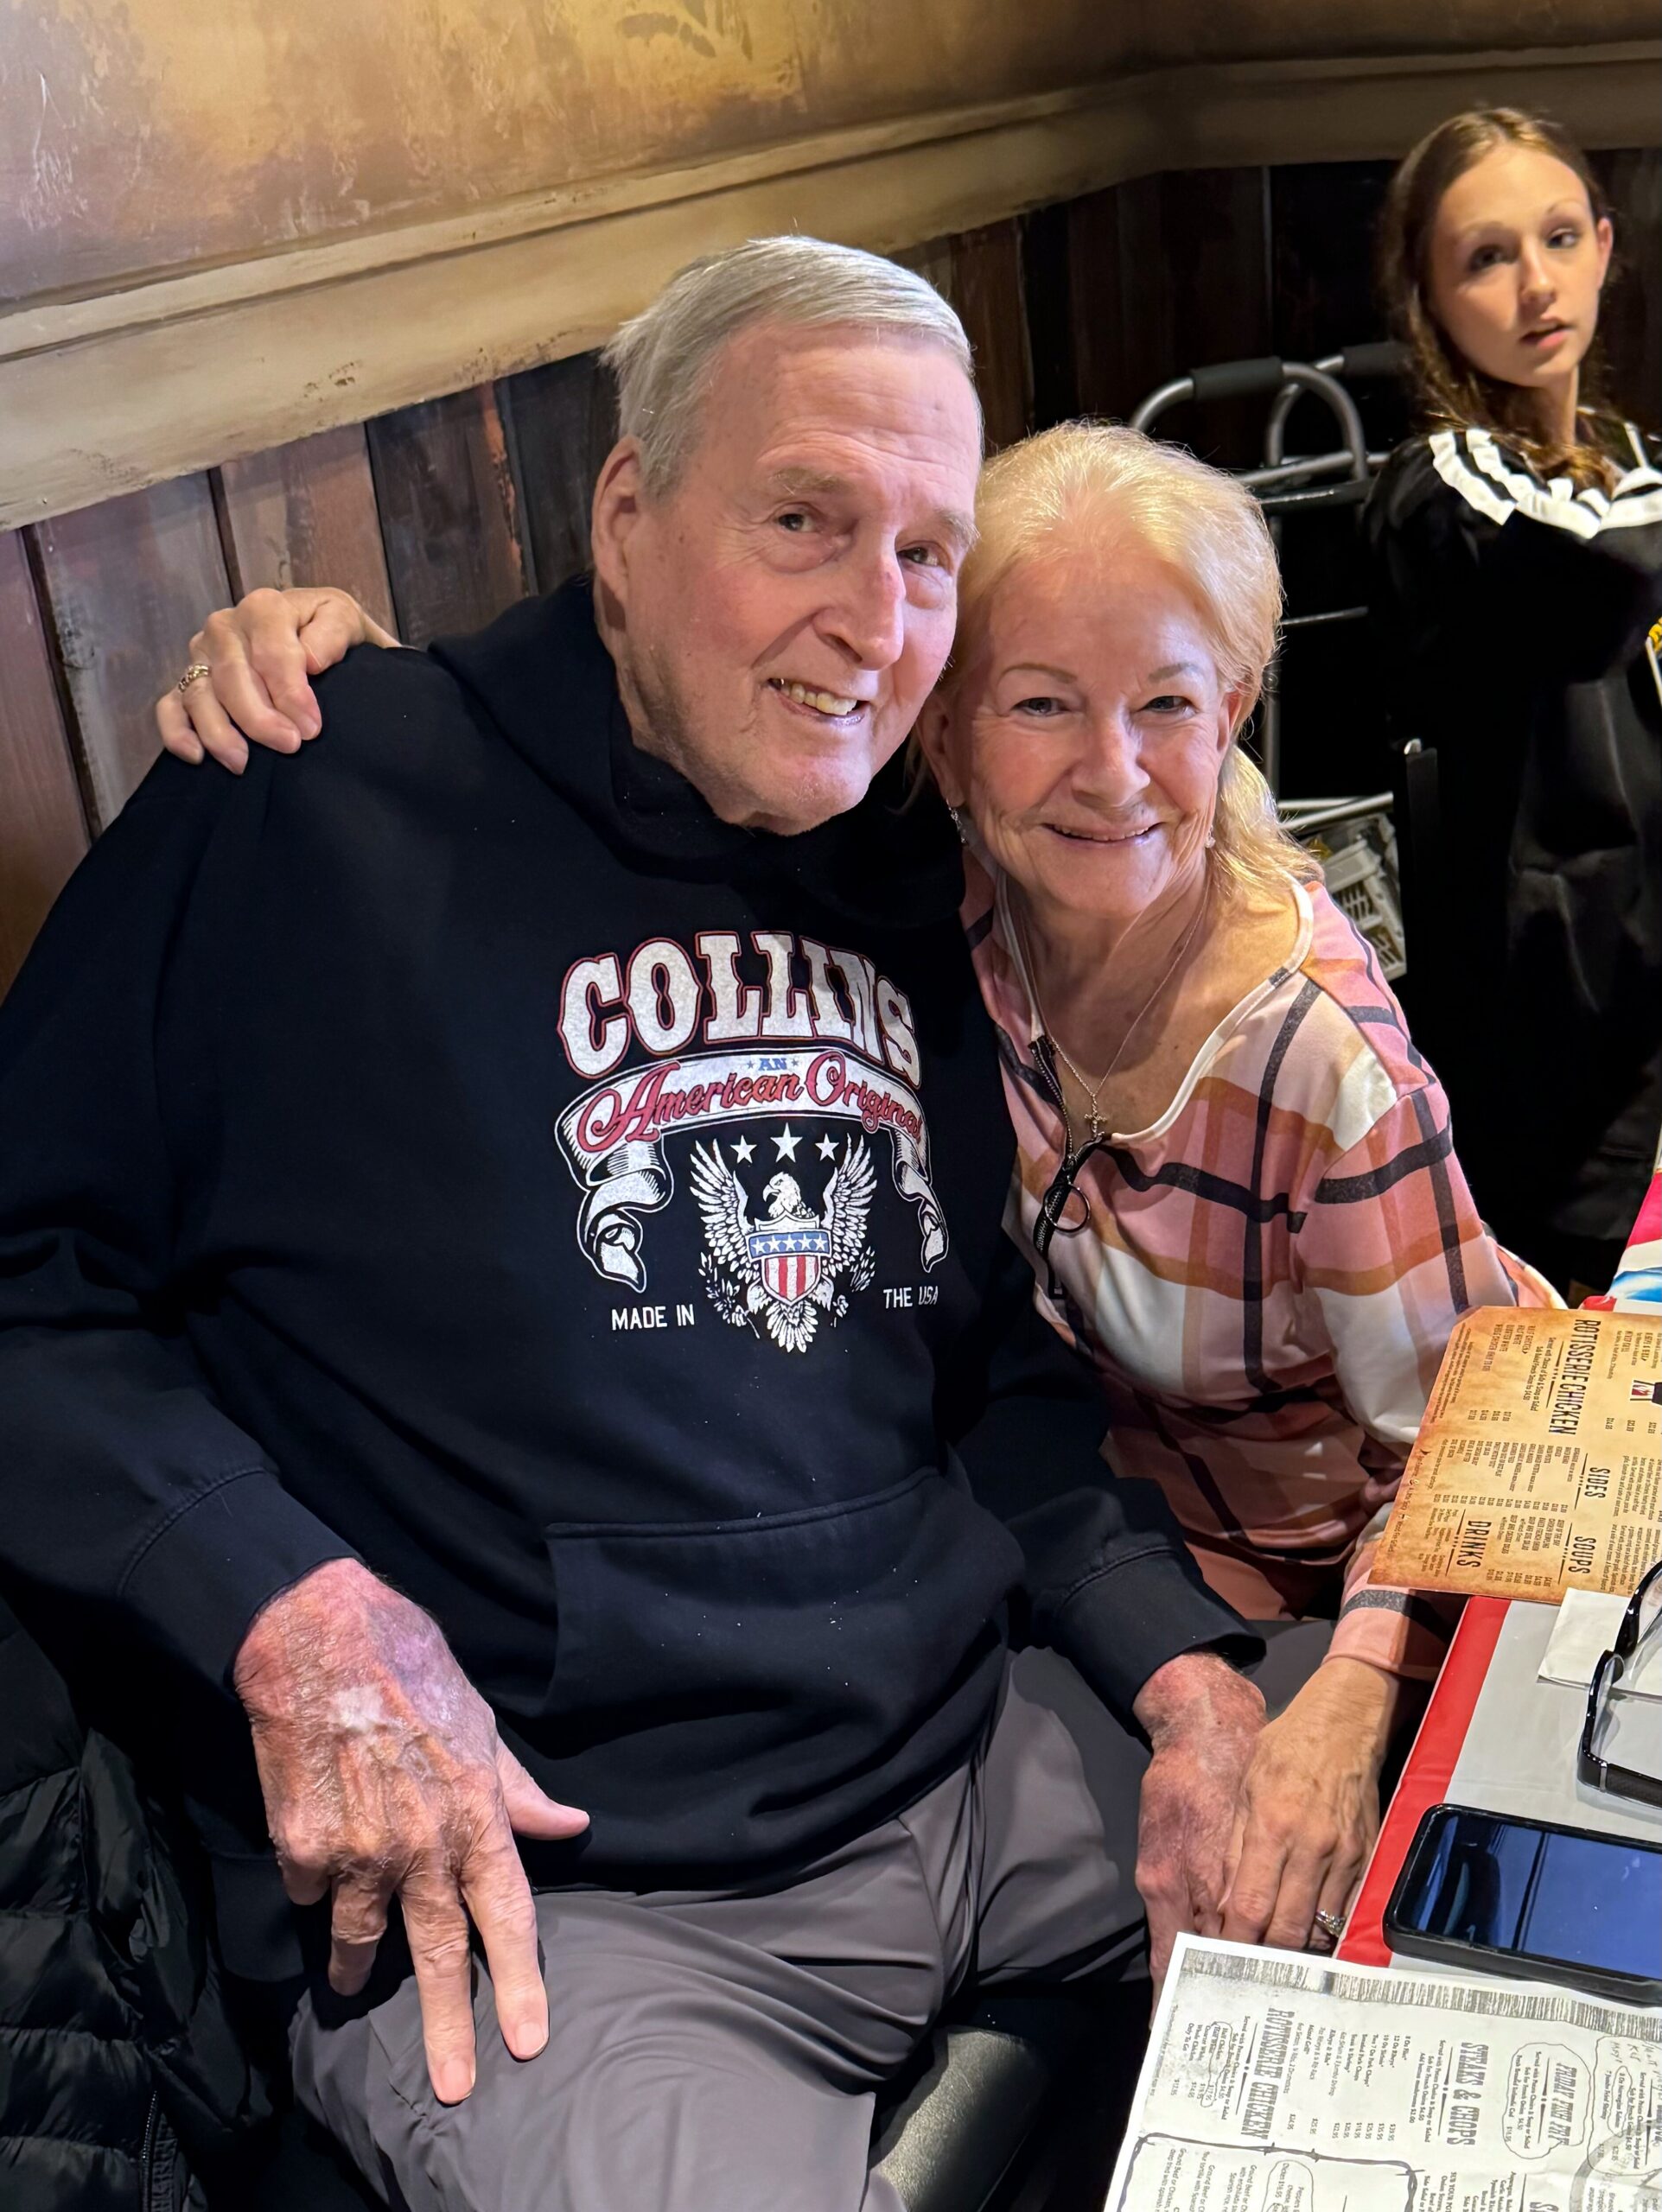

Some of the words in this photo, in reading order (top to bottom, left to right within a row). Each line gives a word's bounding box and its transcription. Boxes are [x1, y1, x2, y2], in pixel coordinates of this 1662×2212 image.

[557, 931, 921, 1090] COLLINS
[759, 1058, 787, 1071] AN
[576, 1061, 803, 1152] American
[611, 1308, 668, 1331] MADE
[677, 1304, 695, 1326] IN
[883, 1287, 912, 1308] THE
[918, 1286, 939, 1306] USA
[1561, 1319, 1601, 1382] ROTISSERIE
[1547, 1382, 1586, 1434] CHICKEN
[1583, 1466, 1610, 1498] SIDES
[1455, 1520, 1492, 1567] DRINKS
[1567, 1535, 1596, 1574] SOUPS
[1253, 2007, 1295, 2078] ROTISSERIE
[1455, 2042, 1489, 2085] STEAKS
[1452, 2088, 1481, 2101] &
[1552, 2063, 1577, 2098] FRIDAY
[1239, 2082, 1279, 2139] CHICKEN
[1445, 2106, 1480, 2145] CHOPS
[1549, 2099, 1573, 2121] FISH
[1546, 2122, 1571, 2145] FRY
